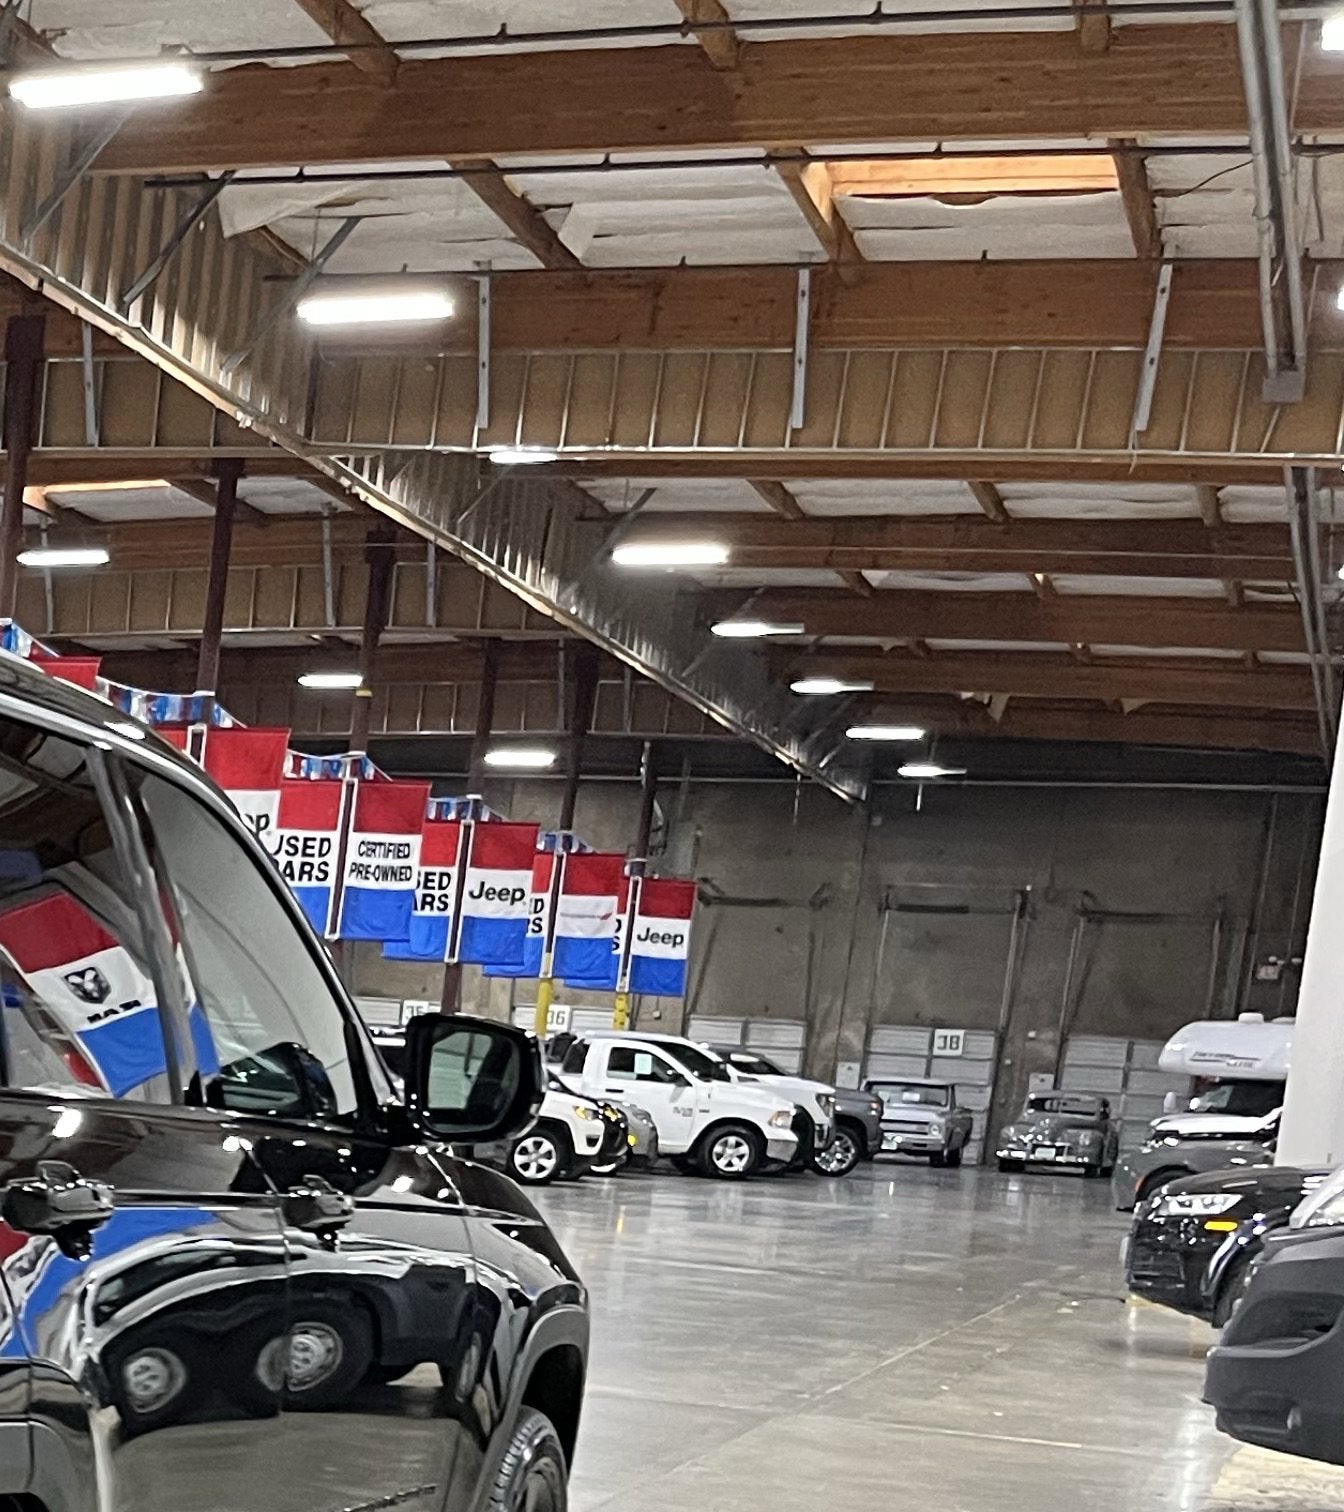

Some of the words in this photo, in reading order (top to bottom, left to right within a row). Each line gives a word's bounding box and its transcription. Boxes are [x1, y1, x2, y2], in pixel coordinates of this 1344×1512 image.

[357, 840, 411, 860] CERTIFIED
[274, 859, 330, 882] ARS
[348, 862, 413, 882] PRE-OWNED
[416, 871, 451, 891] ED
[413, 893, 450, 912] RS
[468, 880, 526, 906] Jeep
[636, 927, 685, 949] Jeep
